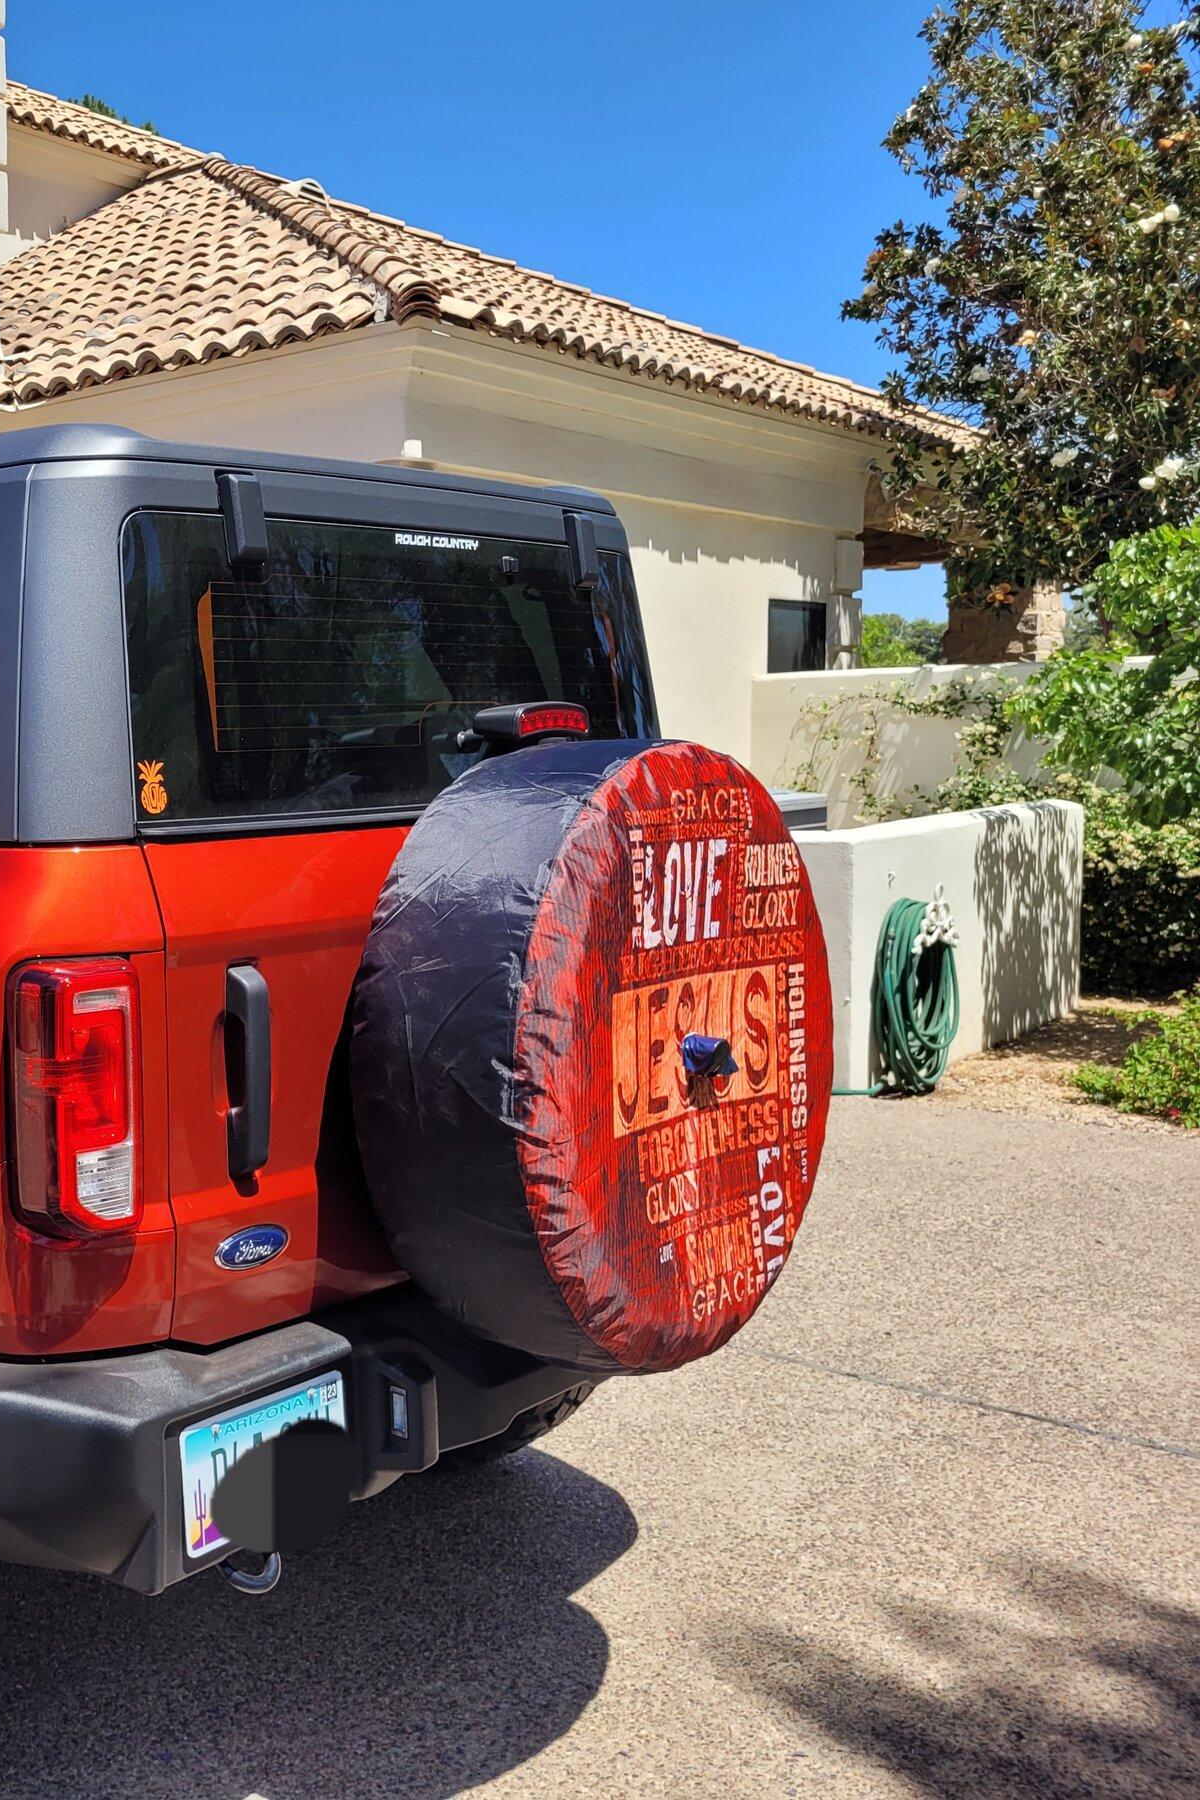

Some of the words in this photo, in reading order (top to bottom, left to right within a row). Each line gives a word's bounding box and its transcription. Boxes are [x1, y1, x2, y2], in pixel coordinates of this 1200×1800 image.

[394, 533, 431, 548] ROUGH
[432, 536, 479, 551] COUNTRY
[670, 788, 740, 823] GRACE
[629, 829, 644, 950] HOPE
[744, 842, 800, 888] HOLINESS
[643, 838, 728, 950] LOVE
[742, 889, 801, 929] GLORY
[620, 930, 805, 984] RIGHTEOUSNESS
[788, 963, 808, 1129] HOLINESS
[637, 1100, 780, 1183] FORGIVENESS
[646, 1168, 700, 1225] GLORY
[235, 1238, 274, 1263] Ford
[685, 1216, 753, 1287] SACRIFICE
[749, 1194, 765, 1293] HOPE
[692, 1265, 755, 1322] GRACE
[224, 1398, 303, 1437] ARIZONA
